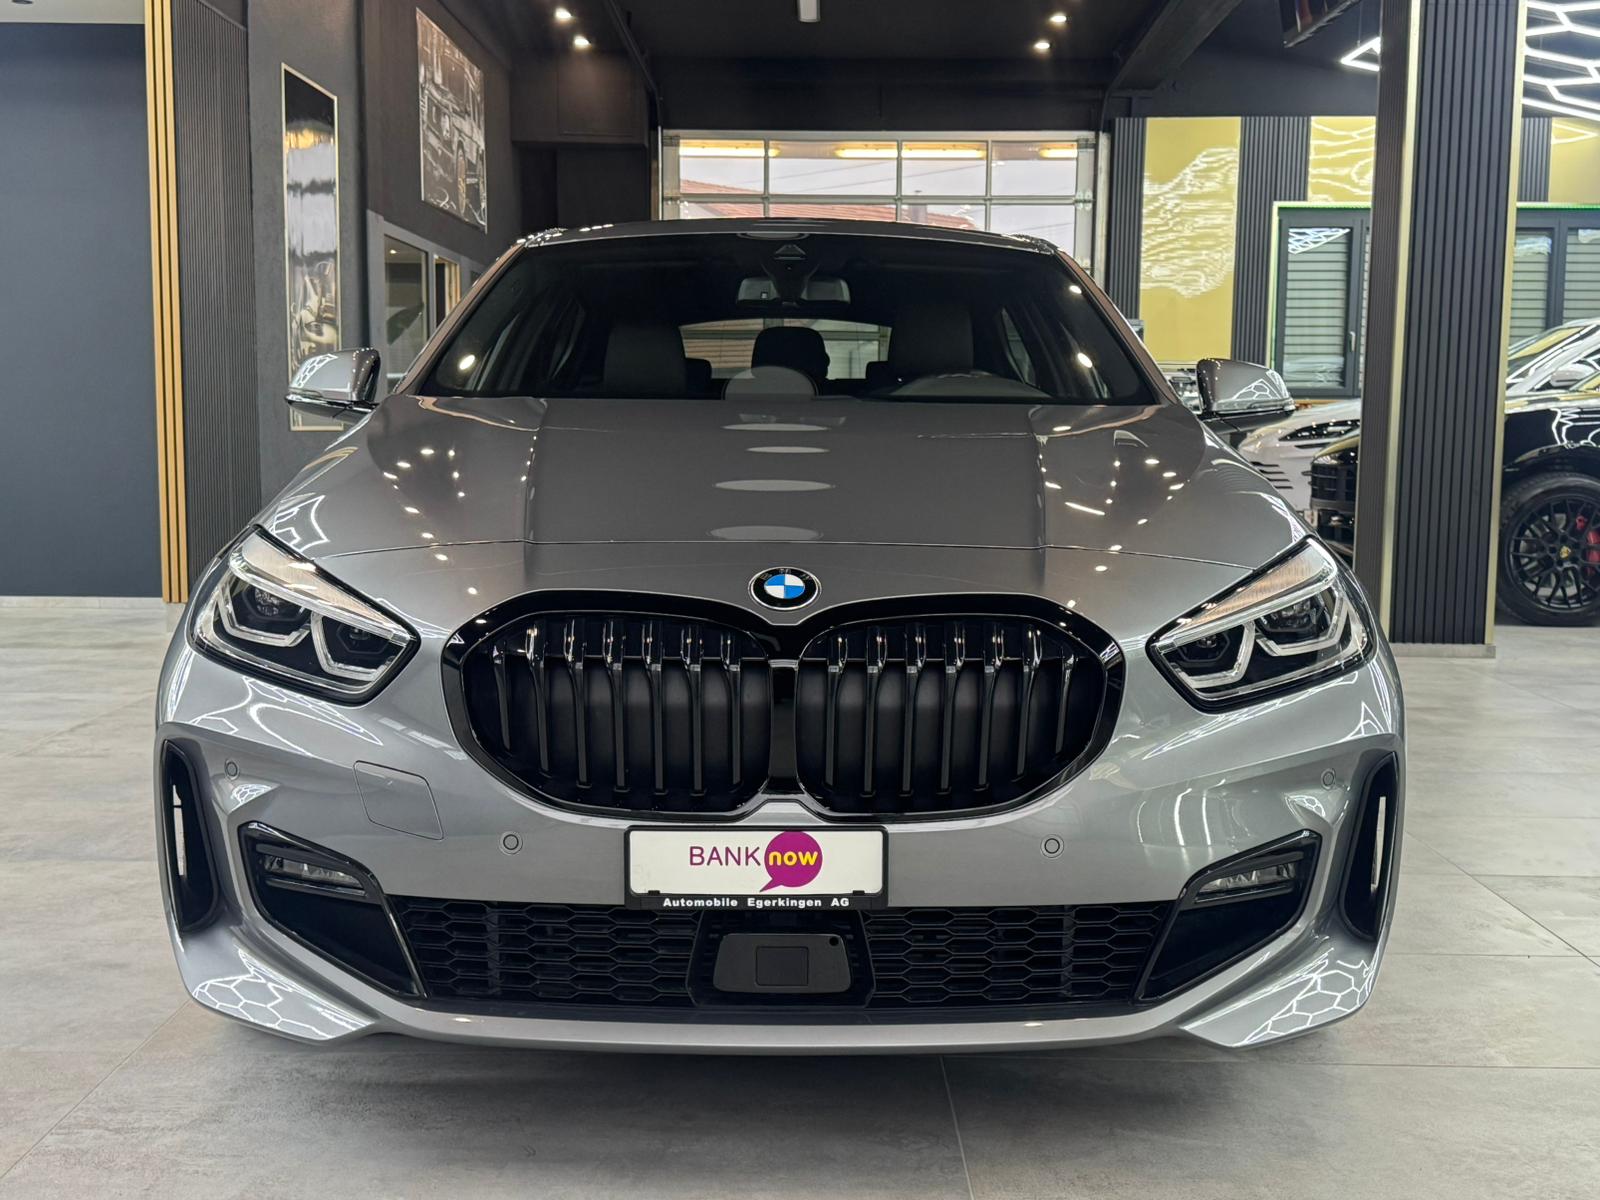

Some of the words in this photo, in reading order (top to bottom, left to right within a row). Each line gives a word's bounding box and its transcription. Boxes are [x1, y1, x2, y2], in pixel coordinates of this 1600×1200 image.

[689, 846, 761, 866] BANK
[768, 851, 819, 866] now
[663, 898, 738, 907] Automobile
[747, 898, 822, 908] Egerkingen
[831, 898, 850, 907] AG
